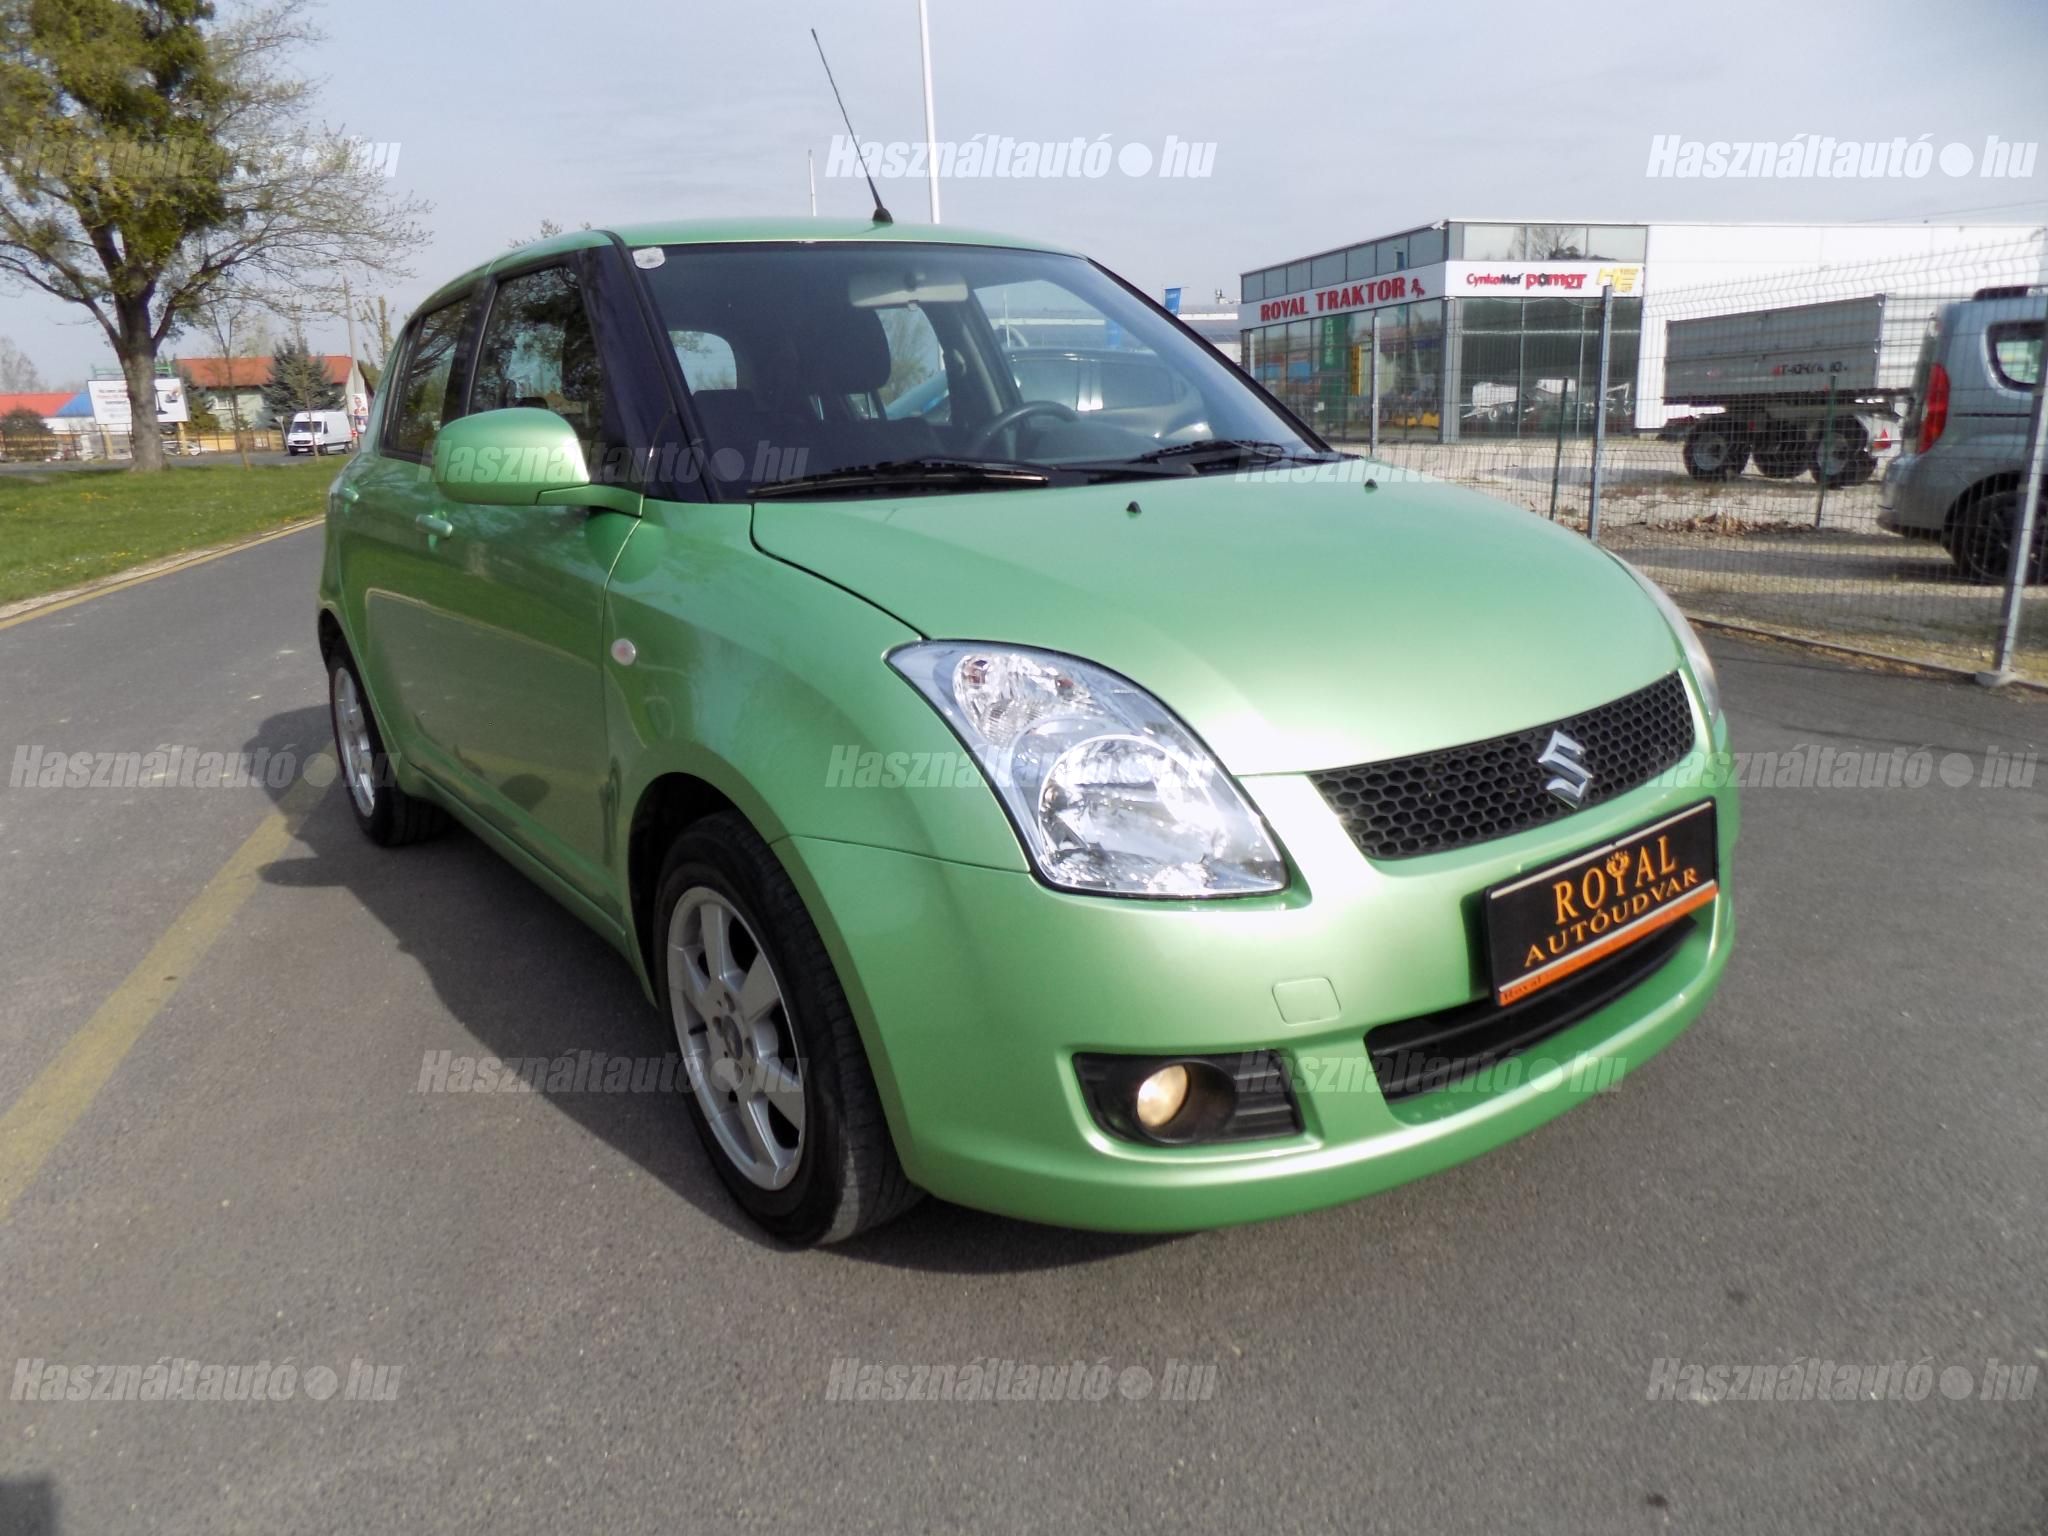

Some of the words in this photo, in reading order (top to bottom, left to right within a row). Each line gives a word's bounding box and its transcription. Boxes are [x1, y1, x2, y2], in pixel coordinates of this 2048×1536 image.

[1260, 297, 1309, 321] ROYAL
[1315, 276, 1406, 311] TRAKTOR
[1553, 836, 1677, 924] ROYAL
